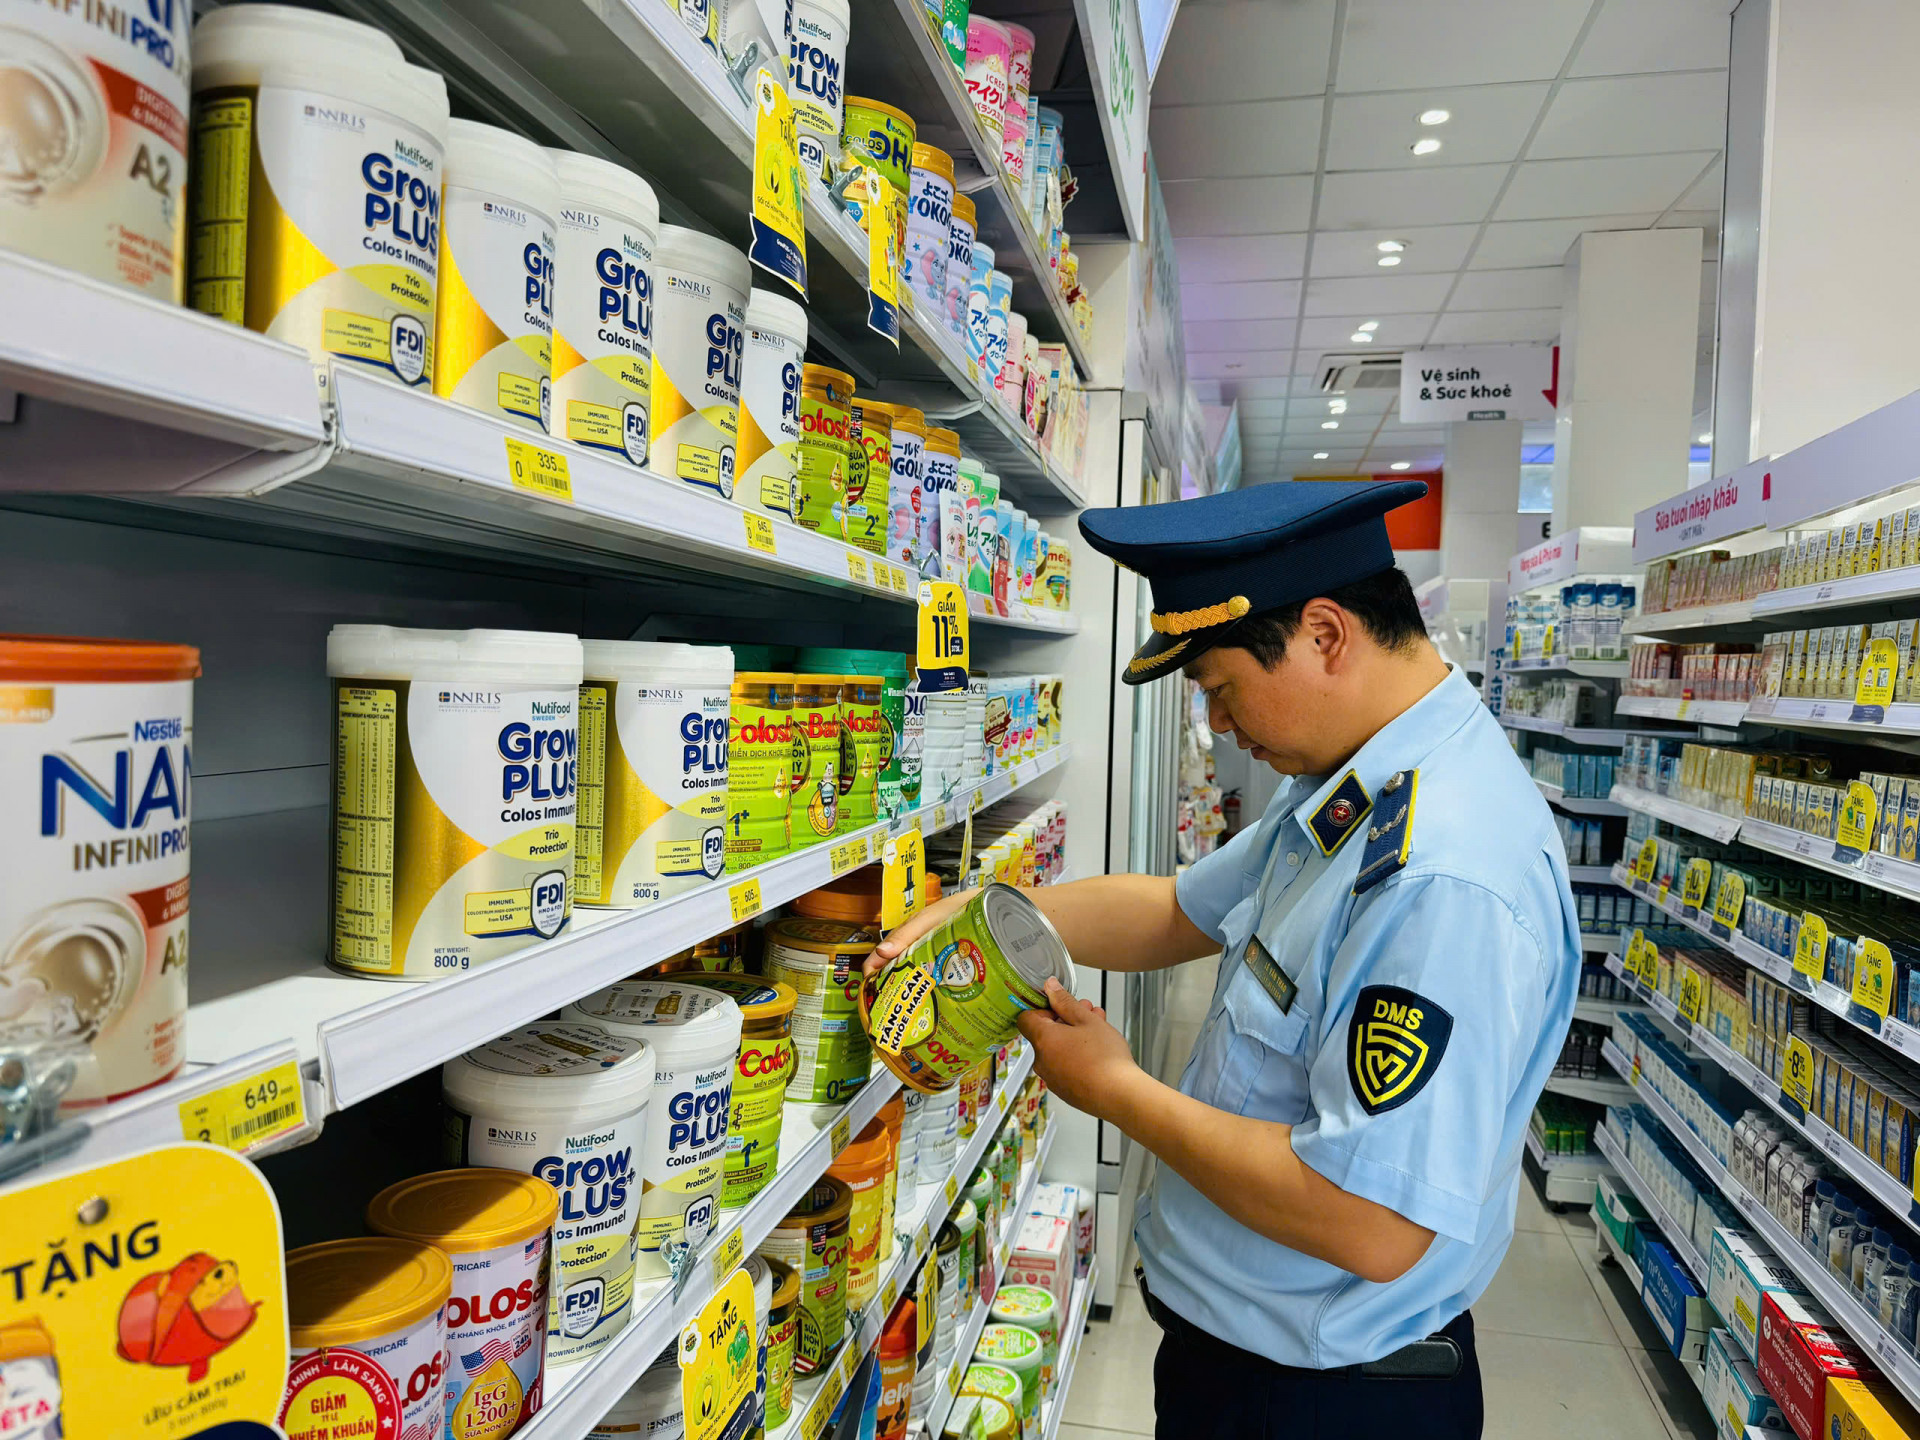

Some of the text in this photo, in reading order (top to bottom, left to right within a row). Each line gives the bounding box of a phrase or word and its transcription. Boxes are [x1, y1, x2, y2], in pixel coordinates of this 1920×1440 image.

[799, 18, 831, 40] Nutifood
[395, 138, 433, 171] Nutifood
[799, 142, 821, 164] FDI
[363, 236, 403, 259] Colos
[405, 275, 421, 289] Trio
[678, 279, 711, 296] NNRIS
[524, 312, 545, 331] Colos
[396, 326, 423, 355] FDI
[598, 328, 630, 349] Colos
[760, 332, 785, 348] NNRIS
[632, 363, 644, 375] Trio
[1421, 367, 1480, 384] Vệ sinh
[705, 383, 728, 400] Colos
[1420, 383, 1512, 400] & Sức khoẻ
[597, 427, 608, 435] USA
[627, 413, 646, 439] FDI
[515, 452, 557, 478] 0 335
[850, 460, 866, 471] NON
[1670, 502, 1688, 527] tươi
[1688, 495, 1711, 523] nhập
[1713, 478, 1738, 511] khẩu
[864, 513, 879, 537] 2+
[932, 616, 959, 658] 11%
[453, 692, 501, 704] NNRIS
[648, 690, 683, 699] NNRIS
[703, 697, 728, 707] Nutifood
[532, 701, 571, 714] Nutifood
[134, 718, 182, 742] Nestlé
[498, 721, 577, 763] Grow
[750, 750, 768, 759] DỊCH
[502, 760, 577, 804] PLUS
[682, 779, 709, 789] Colos
[501, 808, 541, 822] Colos
[729, 810, 749, 836] 1+
[545, 829, 559, 840] Trio
[705, 836, 722, 854] FDI
[73, 825, 188, 871] INFINIPRO
[901, 850, 916, 867] TẶNG
[537, 882, 563, 907] FDI
[633, 889, 659, 900] 800 g
[745, 889, 754, 902] 605
[161, 929, 187, 974] A2
[434, 955, 470, 970] 800 g
[879, 1003, 903, 1045] TĂNG
[901, 970, 924, 1001] CÂN
[890, 1014, 910, 1051] KHỎE
[905, 980, 931, 1015] MẠNH
[1373, 999, 1424, 1031] DMS
[695, 1067, 727, 1085] Nutifood
[695, 1082, 714, 1090] SWEDEN
[245, 1080, 278, 1110] 649
[826, 1078, 845, 1100] 0+
[668, 1081, 733, 1123] Grow
[498, 1130, 537, 1141] NNRIS
[565, 1129, 615, 1149] Nutifood
[669, 1107, 730, 1153] PLUS
[666, 1153, 697, 1168] Colos
[742, 1139, 759, 1167] 1+
[532, 1146, 632, 1189] Grow
[698, 1166, 710, 1177] Trio
[575, 1210, 626, 1237] Immunel
[688, 1203, 711, 1227] FDI
[576, 1243, 594, 1255] Trio
[727, 1236, 738, 1254] 605
[1, 1221, 161, 1302] TẶNG
[566, 1286, 600, 1312] FDI
[567, 1310, 581, 1318] HMO
[586, 1306, 597, 1314] FOS
[457, 1326, 484, 1340] KHÁNG
[508, 1318, 516, 1328] BÉ
[708, 1305, 738, 1349] TẶNG
[803, 1321, 818, 1337] SỮA
[514, 1333, 529, 1349] 24h
[576, 1334, 610, 1352] UP FORMULA
[803, 1336, 819, 1346] NON
[803, 1345, 817, 1359] MỸ
[291, 1360, 388, 1404] MINH LÂM SÀNG
[311, 1390, 347, 1414] GIẢM
[473, 1383, 507, 1410] IgG
[465, 1401, 517, 1428] 1200+
[332, 1415, 374, 1439] KHUẨN
[464, 1417, 515, 1439] SỮA NON 24h
